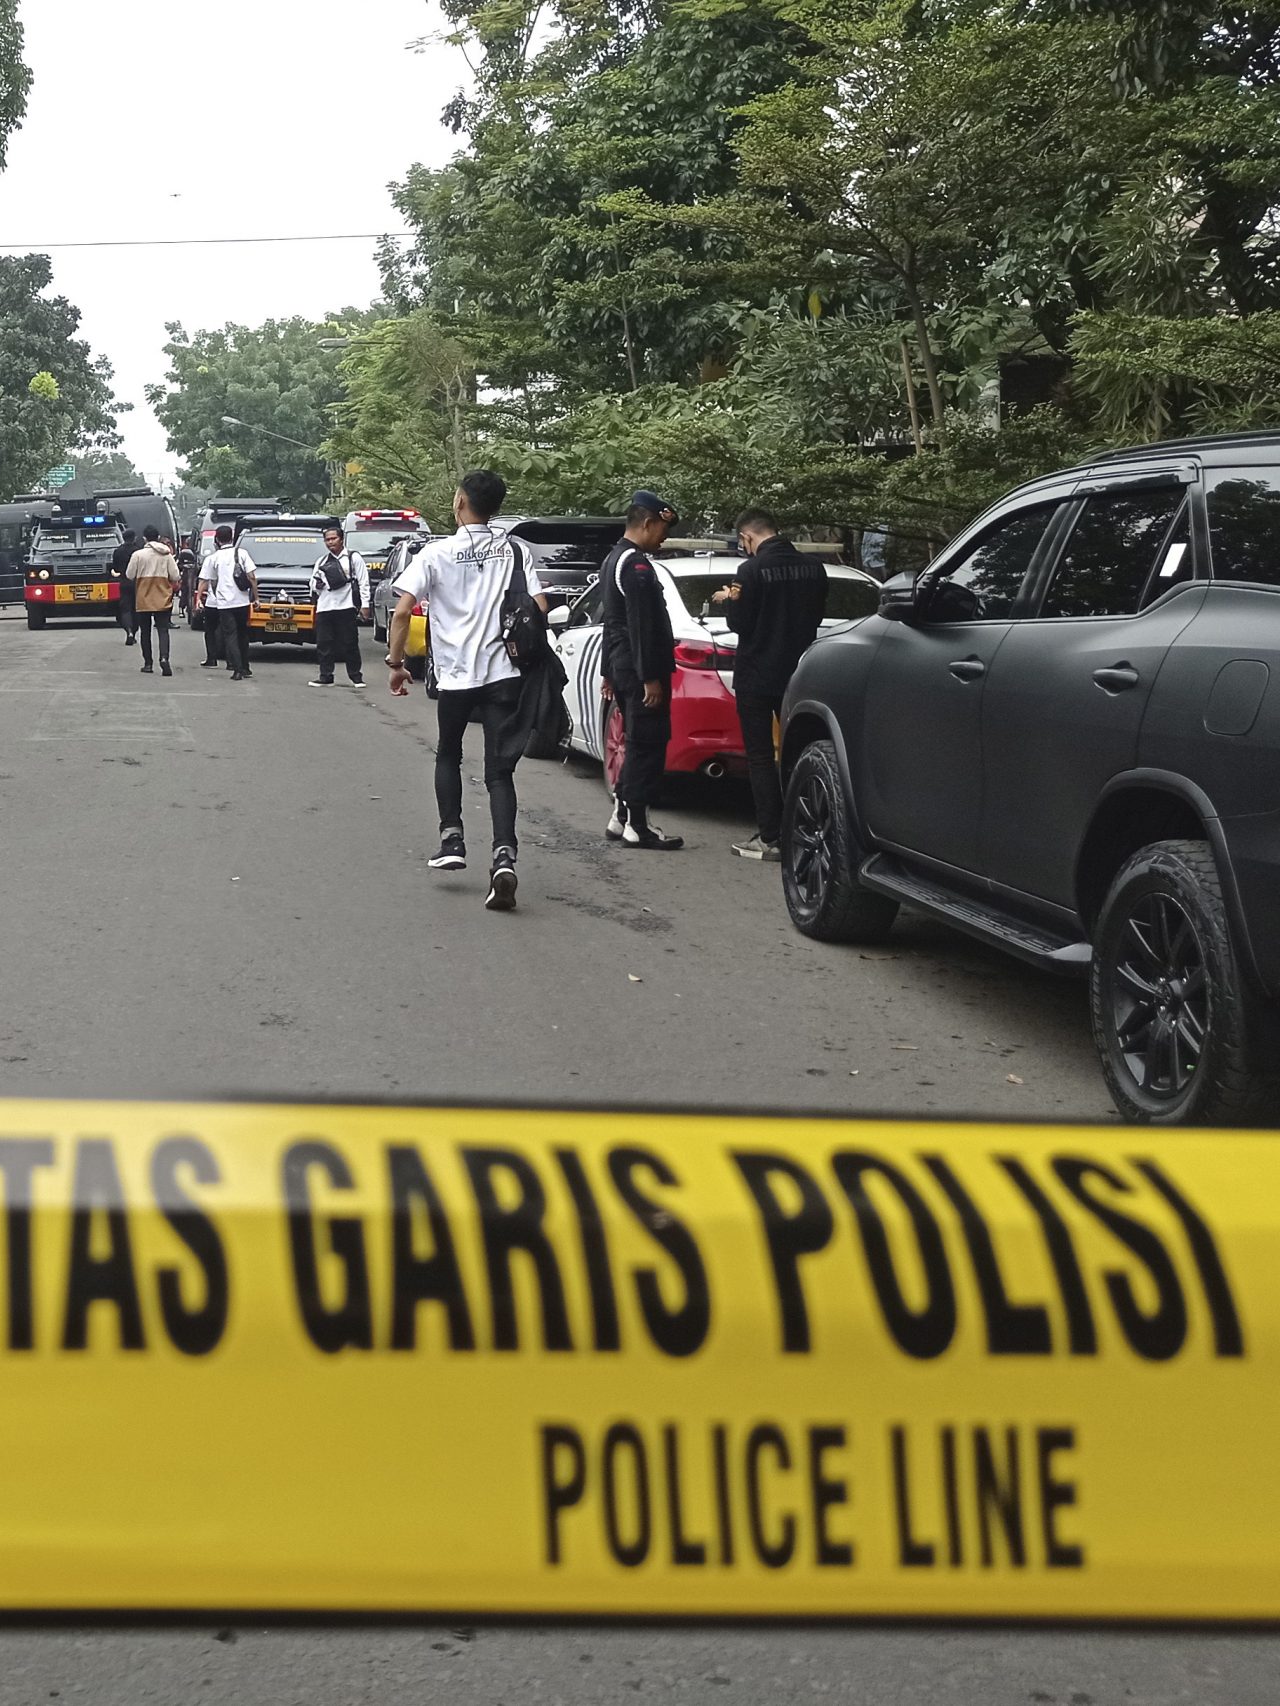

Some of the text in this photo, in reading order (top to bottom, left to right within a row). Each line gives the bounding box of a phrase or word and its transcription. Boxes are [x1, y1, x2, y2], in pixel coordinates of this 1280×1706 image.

[279, 1136, 712, 1359] GARIS
[727, 1145, 1246, 1361] POLISI
[538, 1418, 1086, 1569] POLICE LINE
